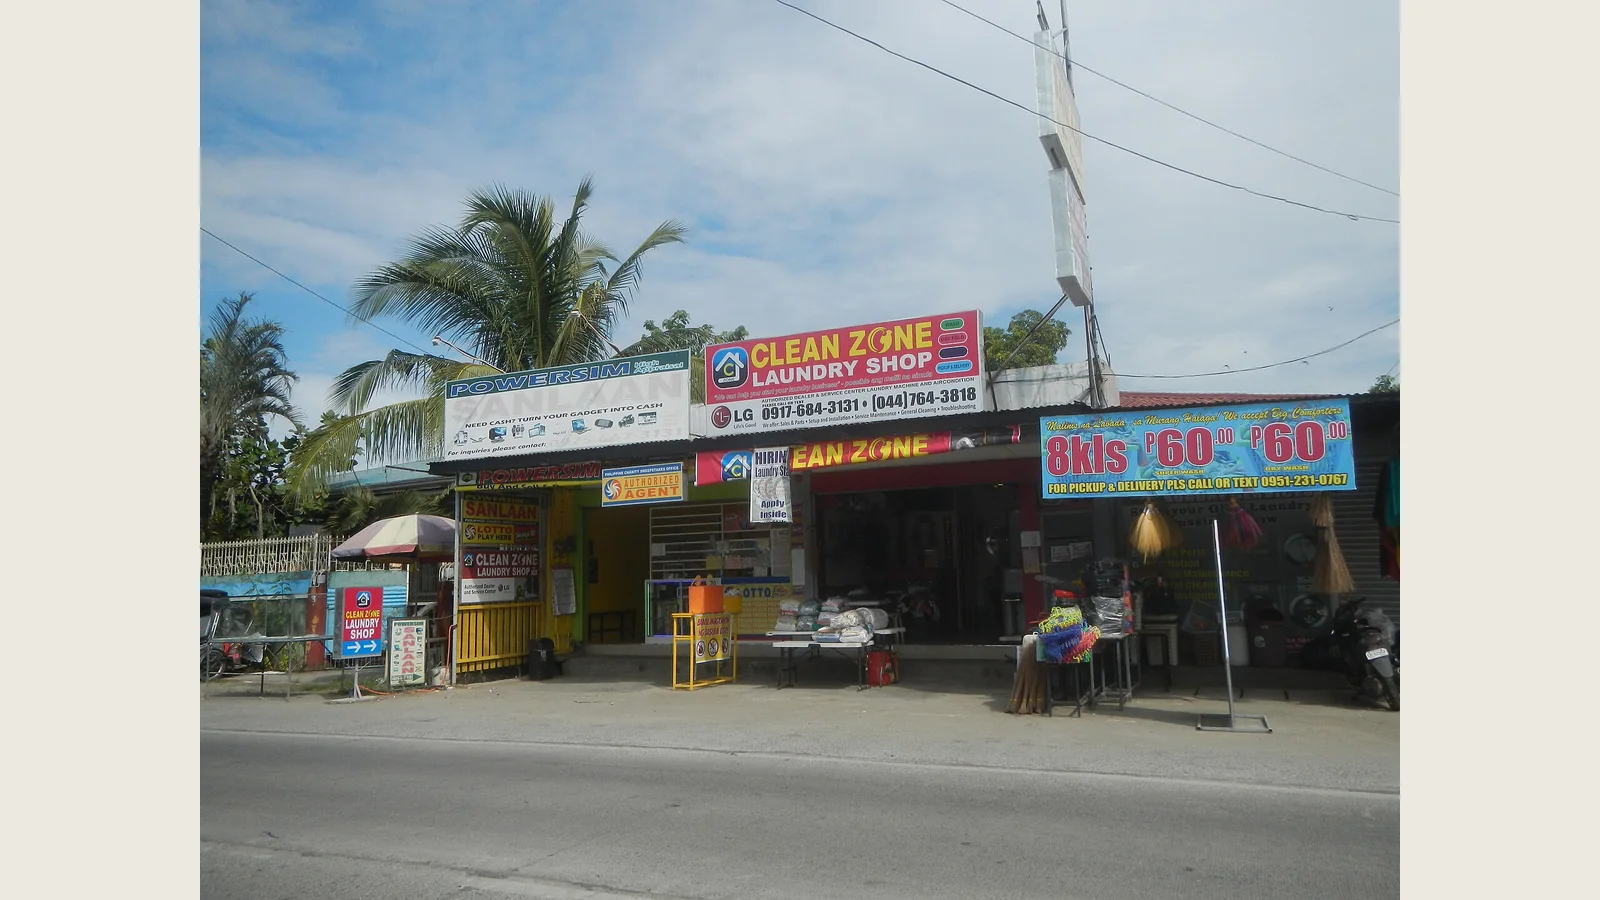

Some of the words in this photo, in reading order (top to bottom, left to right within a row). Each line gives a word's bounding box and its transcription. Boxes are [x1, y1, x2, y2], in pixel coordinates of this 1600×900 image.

[750, 333, 840, 369] CLEAN
[848, 321, 933, 357] ZONE
[633, 362, 684, 374] Appraisal
[752, 360, 859, 387] LAUNDRY
[866, 351, 933, 374] SHOP
[450, 362, 631, 397] POWERSIM
[634, 360, 660, 369] High
[453, 374, 682, 420] SANLAAN
[761, 395, 793, 403] AUTHORIZED
[933, 376, 975, 385] AIRCONDITION
[517, 415, 541, 423] TURN
[543, 412, 568, 420] YOUR
[570, 408, 608, 417] GADGET
[610, 405, 634, 413] INTO
[734, 408, 753, 423] LG
[761, 399, 859, 421] 0917-684-3131
[808, 417, 820, 425] Setup
[829, 414, 852, 423] Installation
[854, 412, 869, 420] Service
[870, 410, 897, 418] Maintenance
[901, 408, 918, 416] General
[918, 407, 937, 415] Cleaning
[940, 403, 976, 412] Troubleshooting
[1046, 421, 1078, 431] Malinis
[1080, 422, 1091, 430] na
[1145, 415, 1180, 426] Murang
[1182, 412, 1221, 424] Halaga!
[1223, 411, 1238, 421] We
[1241, 410, 1268, 421] accept
[1271, 408, 1289, 421] Big
[1291, 406, 1342, 419] Comforters
[460, 447, 491, 455] inquiries
[491, 444, 516, 453] please
[792, 443, 843, 470] EAN
[850, 434, 930, 468] ZONE
[1046, 435, 1129, 476] 8kls
[755, 450, 787, 465] HIRIN
[478, 463, 602, 485] POWERSIM
[755, 466, 779, 478] Laundry
[624, 475, 680, 488] AUTHORIZED
[1048, 483, 1067, 495] FOR
[1068, 482, 1107, 494] PICKUP
[1107, 483, 1116, 492] &
[1117, 480, 1165, 493] DELIVERY
[1166, 479, 1187, 491] PLS
[1187, 478, 1214, 490] CALL
[1215, 478, 1231, 489] OR
[1232, 477, 1259, 488] TEXT
[1261, 474, 1348, 488] 0951-231-0767
[624, 486, 679, 499] AGENT
[465, 501, 537, 519] SANLAAN
[761, 499, 785, 508] Apply
[760, 509, 787, 519] Inside
[477, 525, 512, 534] LOTTO
[476, 553, 509, 566] CLEAN
[511, 553, 538, 566] ZONE
[477, 567, 511, 577] LAUNDRY
[512, 567, 530, 576] SHOP
[345, 610, 364, 619] CLEAN
[345, 618, 380, 630] LAUNDRY
[350, 628, 375, 640] SHOP
